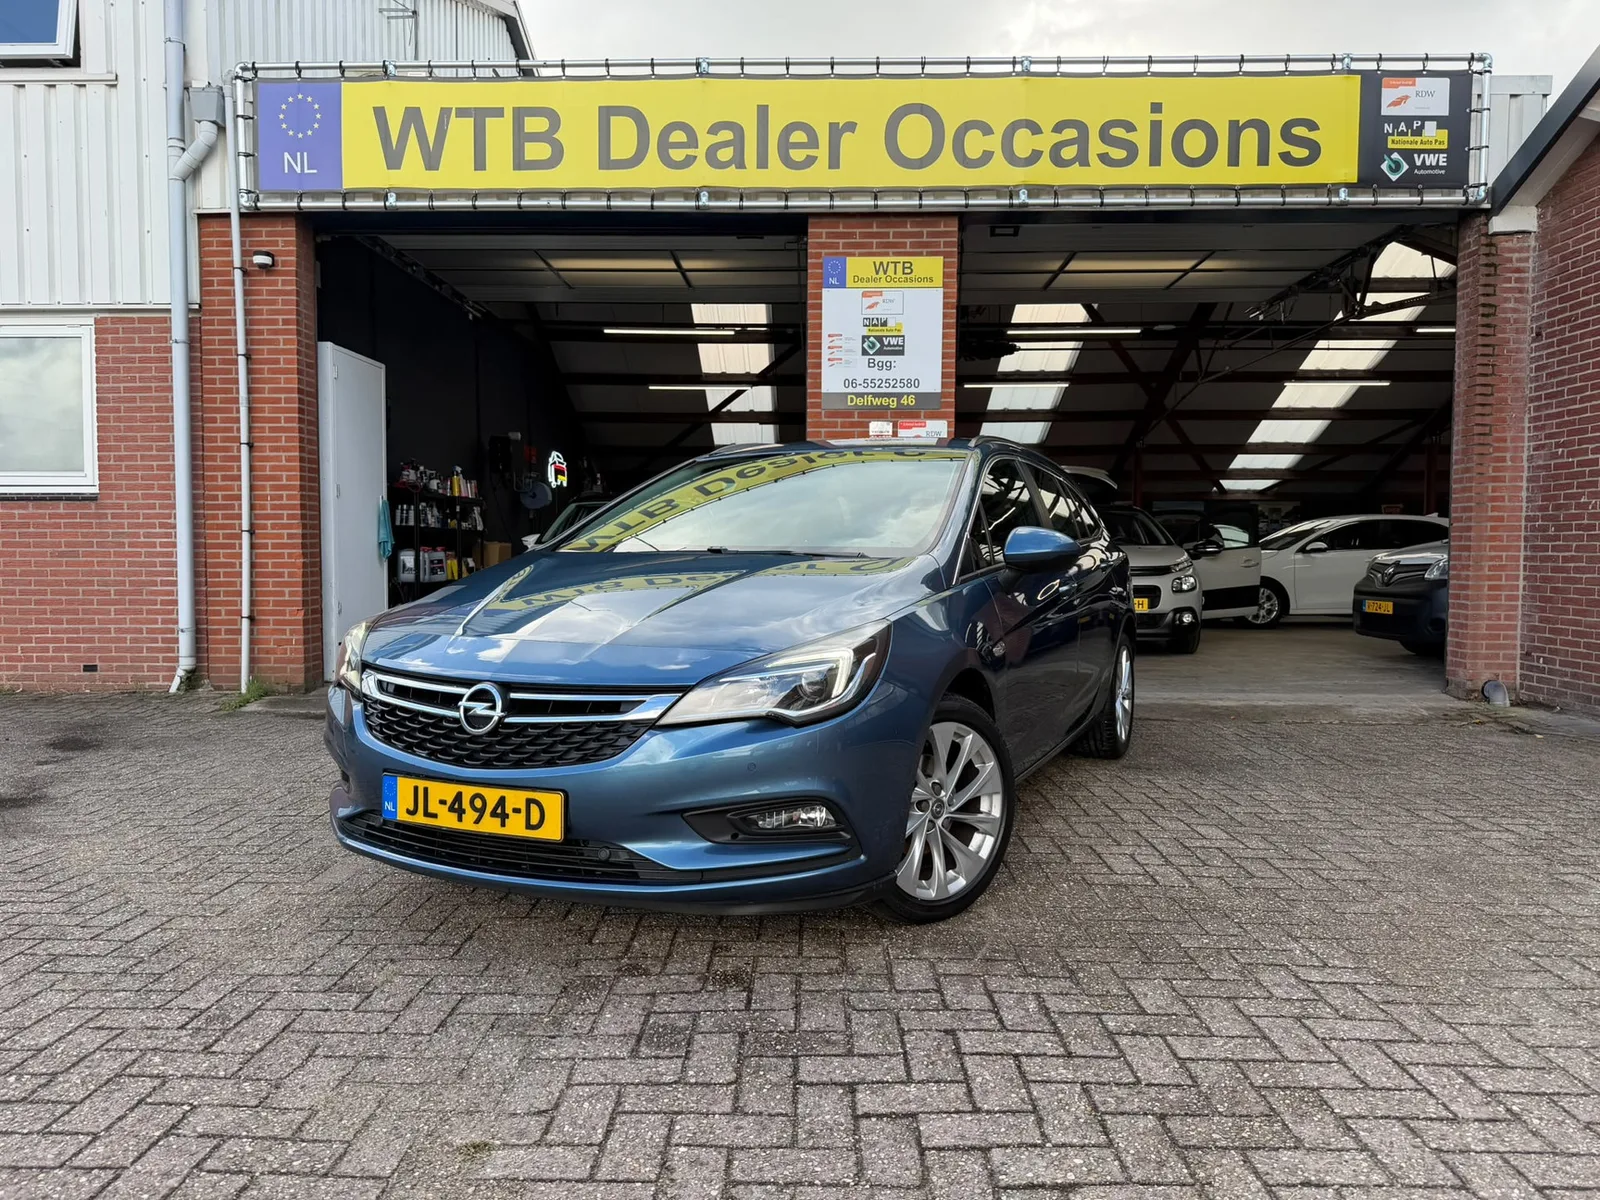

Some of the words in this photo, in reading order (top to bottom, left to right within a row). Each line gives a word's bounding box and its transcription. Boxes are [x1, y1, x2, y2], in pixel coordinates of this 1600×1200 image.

[1415, 90, 1436, 98] RDW
[372, 105, 564, 172] WTB
[597, 104, 857, 172] Dealer
[884, 101, 1322, 170] Occasions
[1391, 138, 1418, 146] Nationale
[1420, 138, 1433, 146] Auto
[1434, 138, 1445, 146] Pas
[283, 151, 317, 174] NL
[1413, 153, 1448, 166] VWE
[873, 261, 914, 275] WTB
[828, 277, 839, 285] NL
[853, 274, 882, 284] Dealer
[885, 274, 934, 284] Occasions
[883, 337, 904, 345] VWE
[867, 358, 897, 371] Bgg:
[843, 378, 920, 389] 06-55252580
[847, 395, 897, 408] Delfweg
[900, 395, 916, 406] 46
[384, 801, 396, 812] NL
[405, 785, 546, 831] JL-494-D
